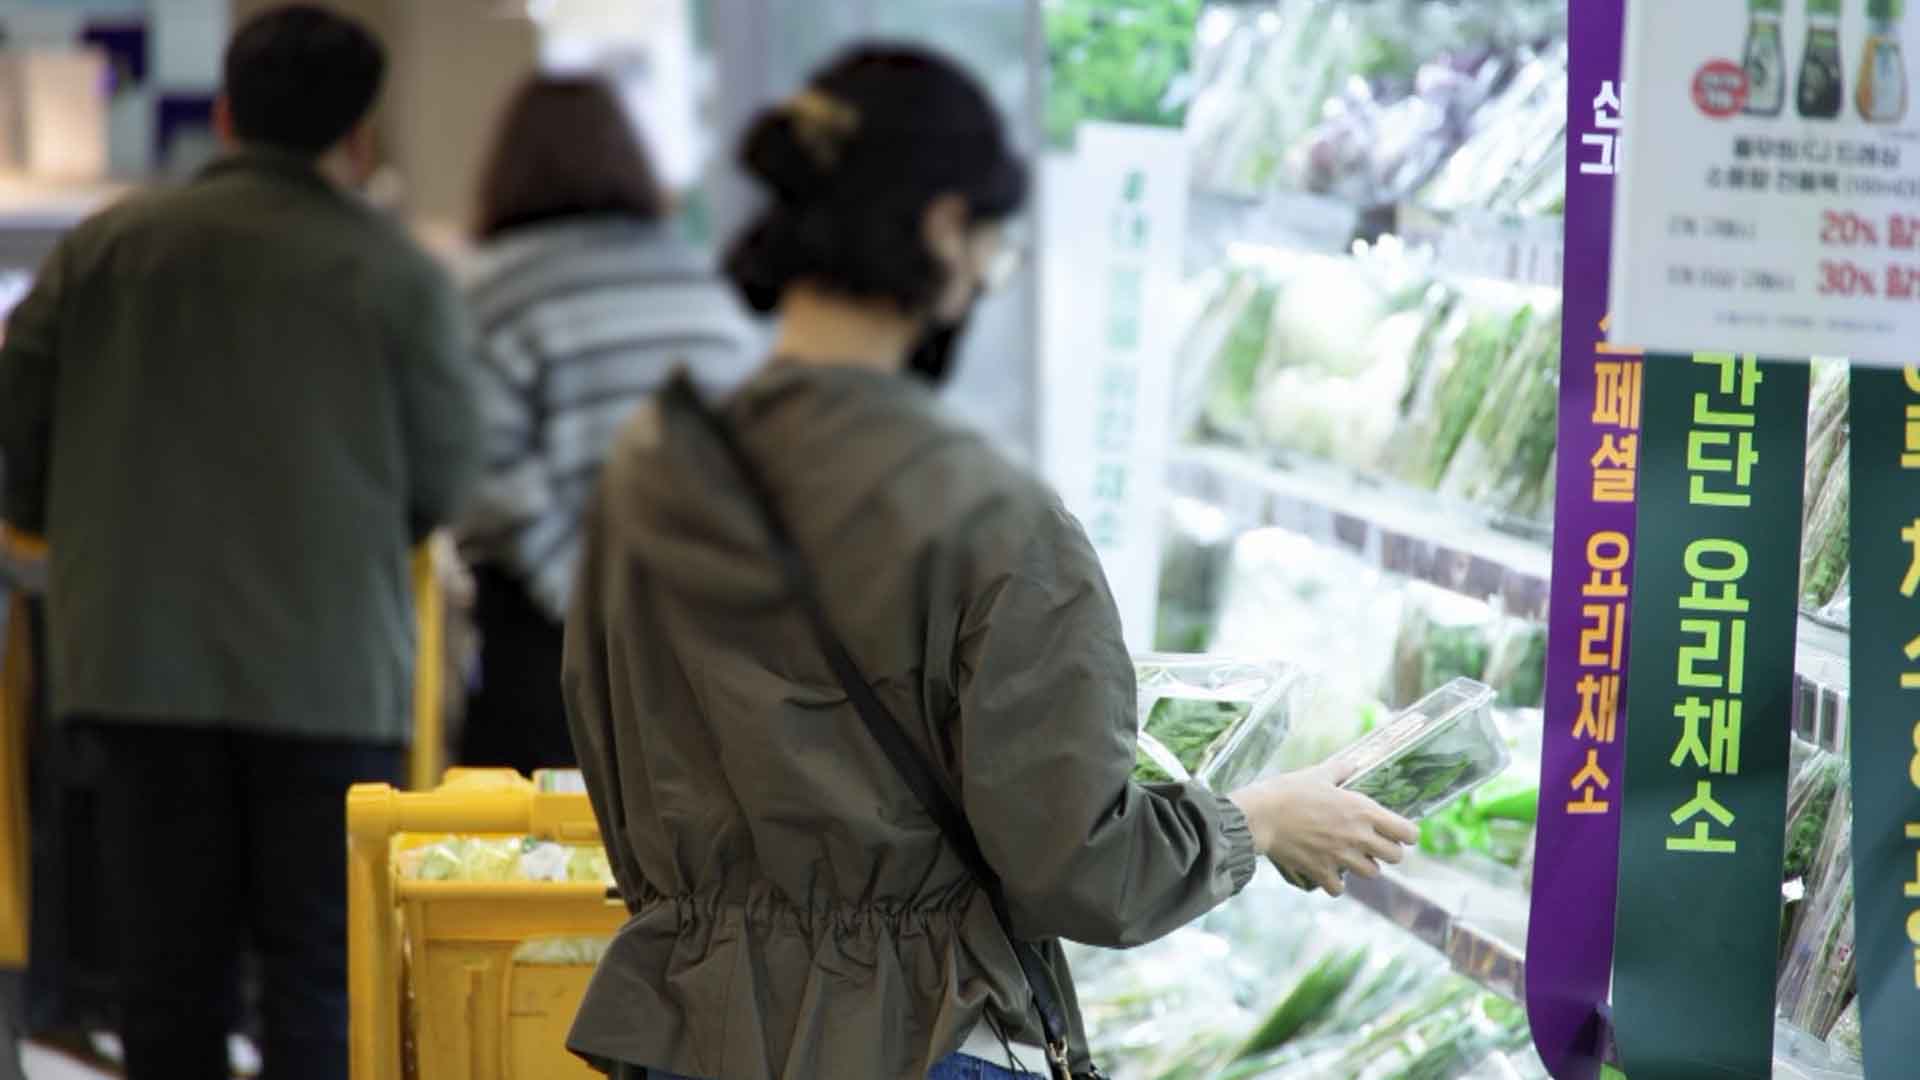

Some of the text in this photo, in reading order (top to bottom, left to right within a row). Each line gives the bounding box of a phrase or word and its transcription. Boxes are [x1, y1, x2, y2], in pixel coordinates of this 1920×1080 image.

[1818, 259, 1875, 296] 30%
[1820, 209, 1878, 247] 20%
[1566, 530, 1630, 814] 요리채소
[1665, 352, 1763, 853] 간단 요리채소
